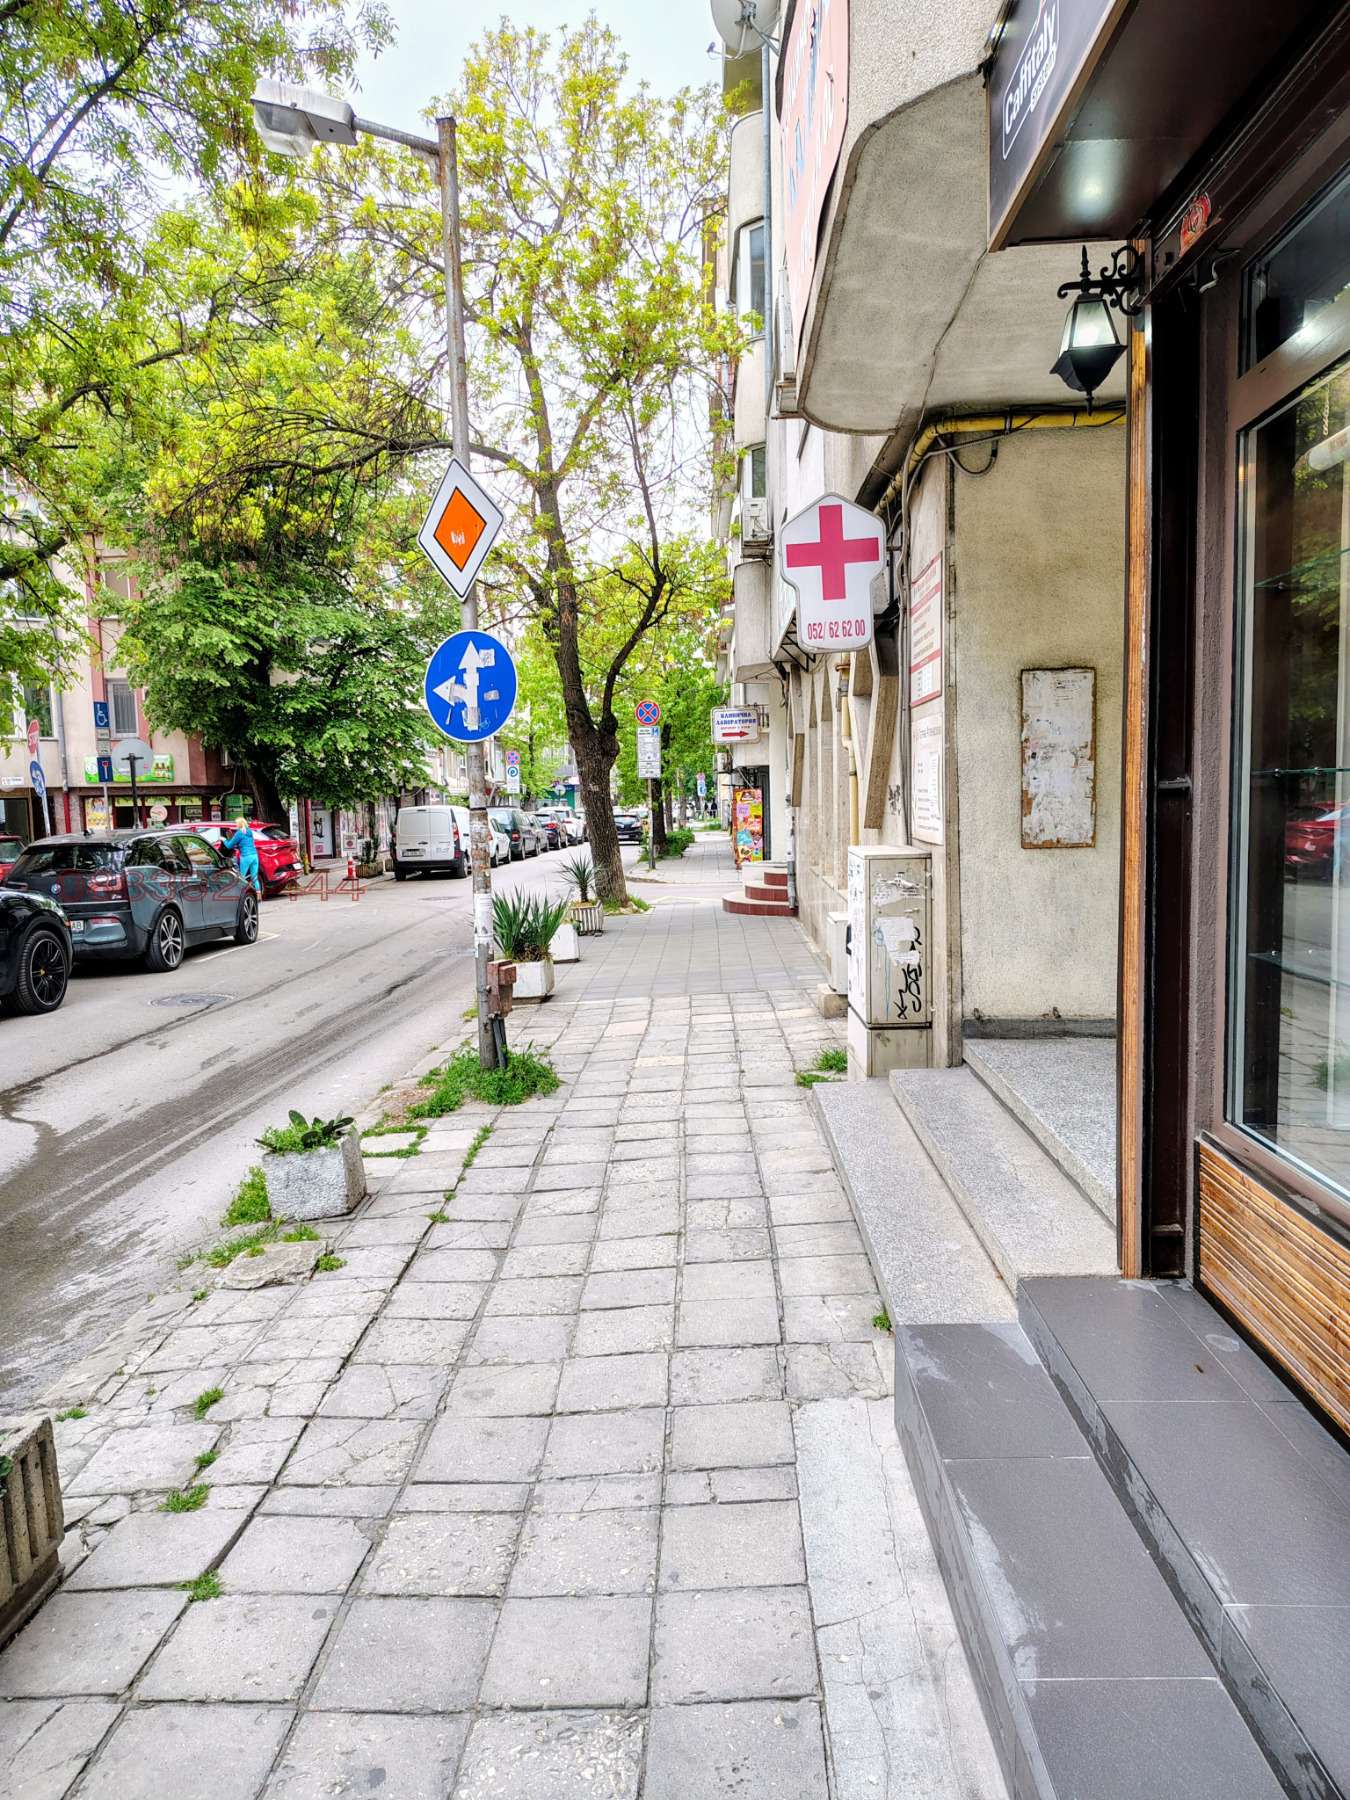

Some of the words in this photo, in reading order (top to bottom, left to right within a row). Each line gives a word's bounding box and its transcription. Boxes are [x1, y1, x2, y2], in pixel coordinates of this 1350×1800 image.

[1005, 3, 1056, 135] Caffitaly
[829, 621, 840, 638] 62
[842, 620, 852, 638] 62
[855, 619, 866, 637] 00
